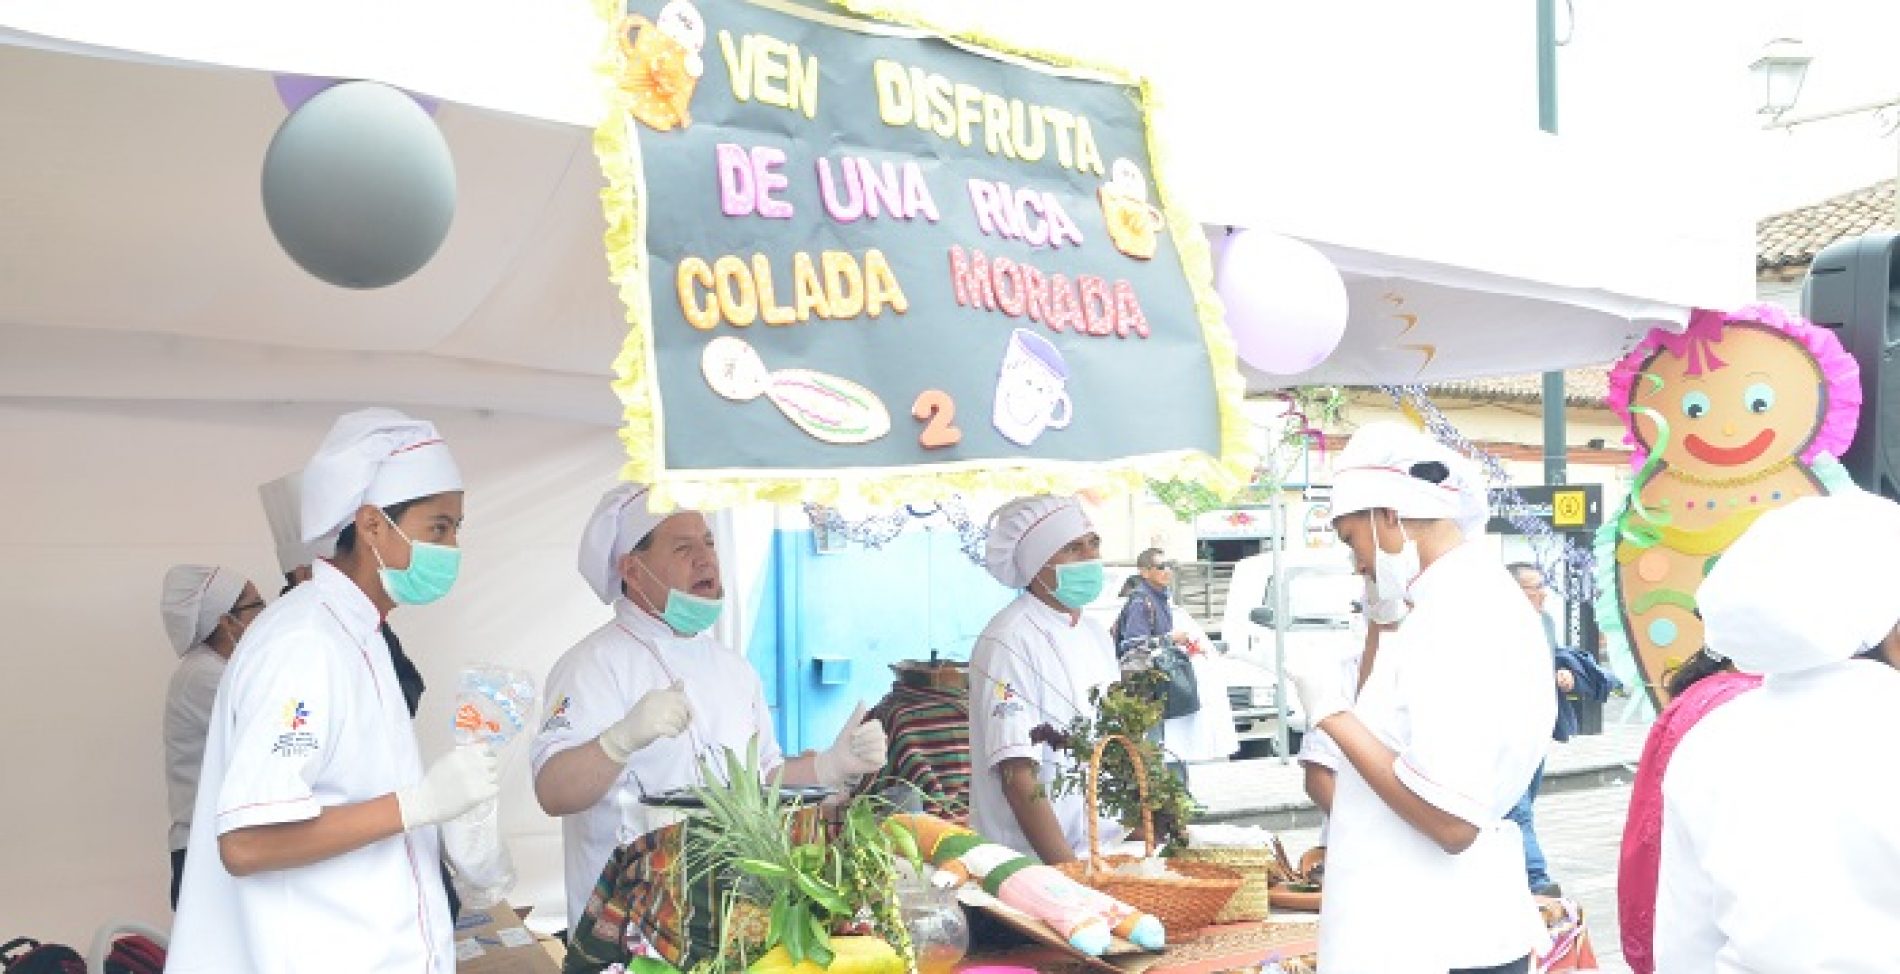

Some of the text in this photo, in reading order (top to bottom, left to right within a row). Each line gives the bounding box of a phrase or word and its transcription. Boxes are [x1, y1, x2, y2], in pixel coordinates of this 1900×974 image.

[718, 30, 1104, 176] VEN DISFRUTA
[716, 143, 1084, 249] DE UNA RICA
[677, 246, 1150, 339] COLADA MORADA
[911, 390, 963, 449] 2
